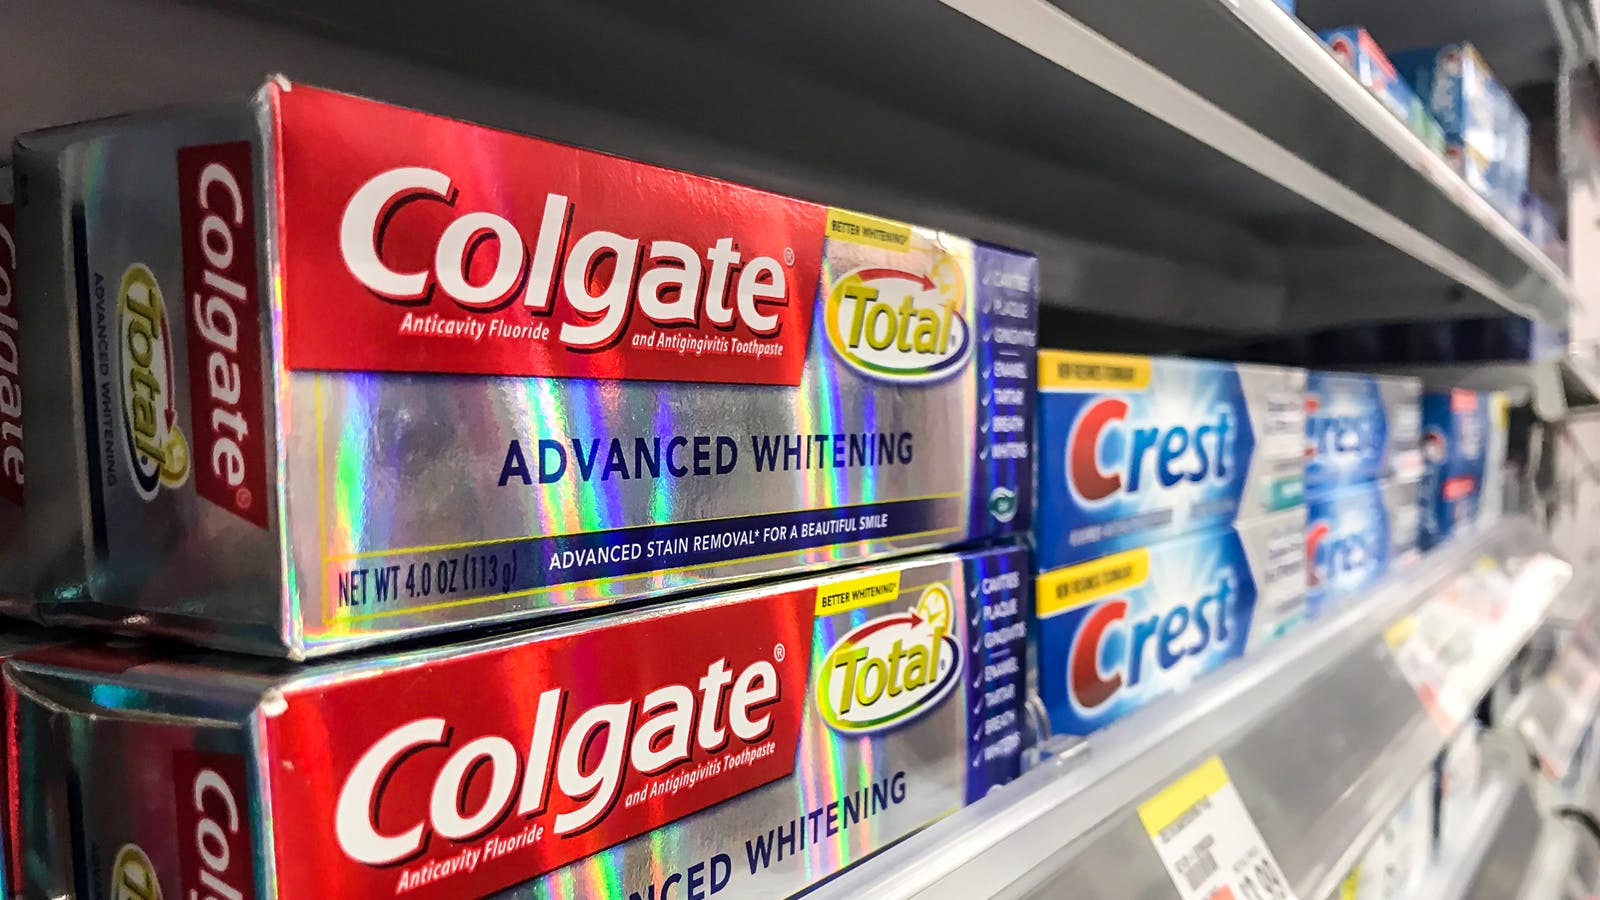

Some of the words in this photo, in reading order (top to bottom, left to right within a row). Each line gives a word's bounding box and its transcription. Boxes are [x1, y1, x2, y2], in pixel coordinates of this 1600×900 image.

[339, 166, 788, 346] Colgate
[831, 219, 860, 236] BETTER
[93, 271, 110, 377] ADVANCED
[194, 162, 247, 488] Colgate
[400, 312, 485, 341] Anticavity
[488, 318, 550, 342] Fluoride
[631, 332, 655, 347] and
[656, 332, 729, 355] Antigingivitis
[730, 341, 784, 359] Toothpaste
[844, 285, 956, 355] Total
[126, 288, 166, 465] Total
[101, 382, 119, 487] WHITENING
[497, 434, 738, 487] ADVANCED
[752, 432, 913, 473] WHITENING
[1069, 398, 1230, 502] Crest
[338, 568, 370, 608] NET
[374, 565, 401, 603] WT
[405, 561, 431, 598] 4.0
[437, 558, 458, 594] OZ
[463, 553, 498, 591] (113
[502, 549, 518, 594] g)
[548, 543, 642, 571] ADVANCED
[646, 536, 689, 558] STAIN
[763, 526, 788, 542] FOR
[789, 524, 799, 540] A
[801, 517, 857, 539] BEAUTIFUL
[859, 513, 889, 530] SMILE
[821, 591, 850, 608] BETTER
[834, 625, 945, 716] Total
[1069, 599, 1231, 709] Crest
[334, 657, 779, 866] Colgate
[624, 788, 648, 808] and
[649, 758, 722, 800] Antigingivitis
[723, 740, 776, 773] Toothpaste
[190, 769, 244, 900] Col
[396, 848, 481, 894] Anticavity
[483, 822, 545, 862] Fluoride
[745, 770, 906, 876] WHITENING
